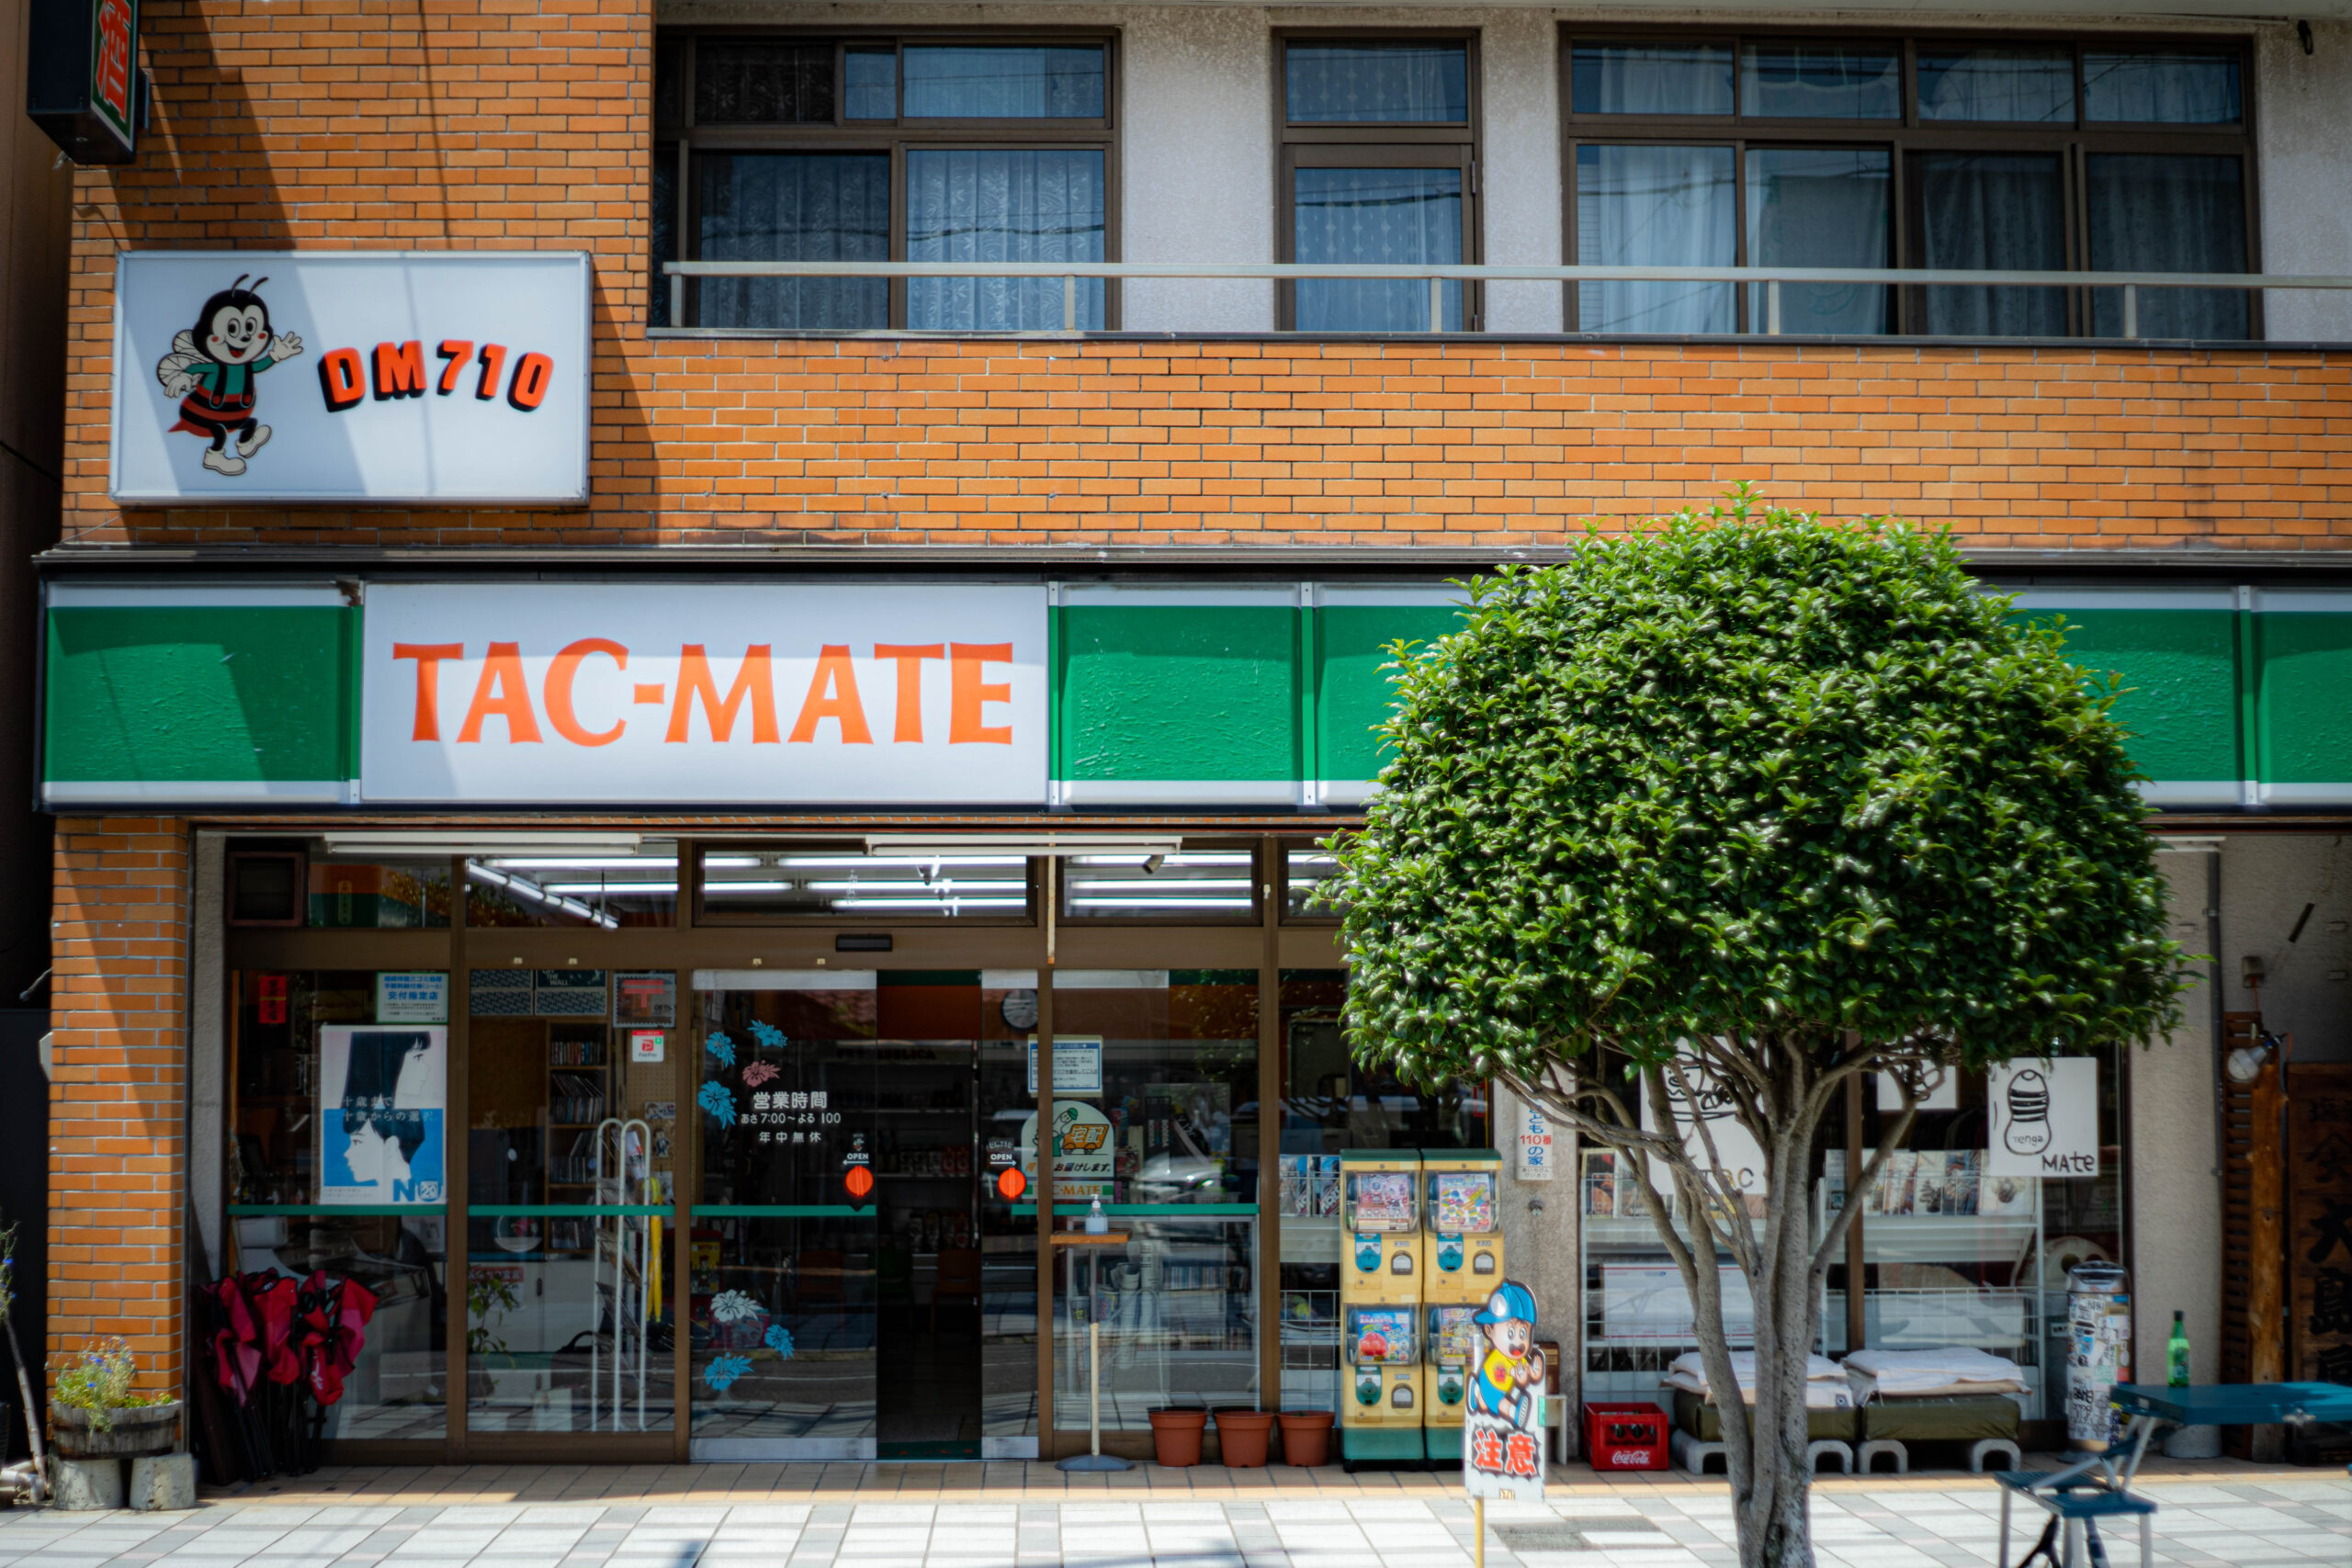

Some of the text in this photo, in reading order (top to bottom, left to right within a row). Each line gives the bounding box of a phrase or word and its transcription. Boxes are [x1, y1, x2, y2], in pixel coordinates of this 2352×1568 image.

[317, 339, 554, 412] DM710
[392, 637, 1012, 747] TAC-MATE
[752, 1091, 828, 1110] 営業時間
[759, 1131, 822, 1144] 年中無休
[1071, 1126, 1104, 1143] 宅配
[1474, 1427, 1537, 1476] 注意
[1611, 1450, 1650, 1465] Coca-Cola
